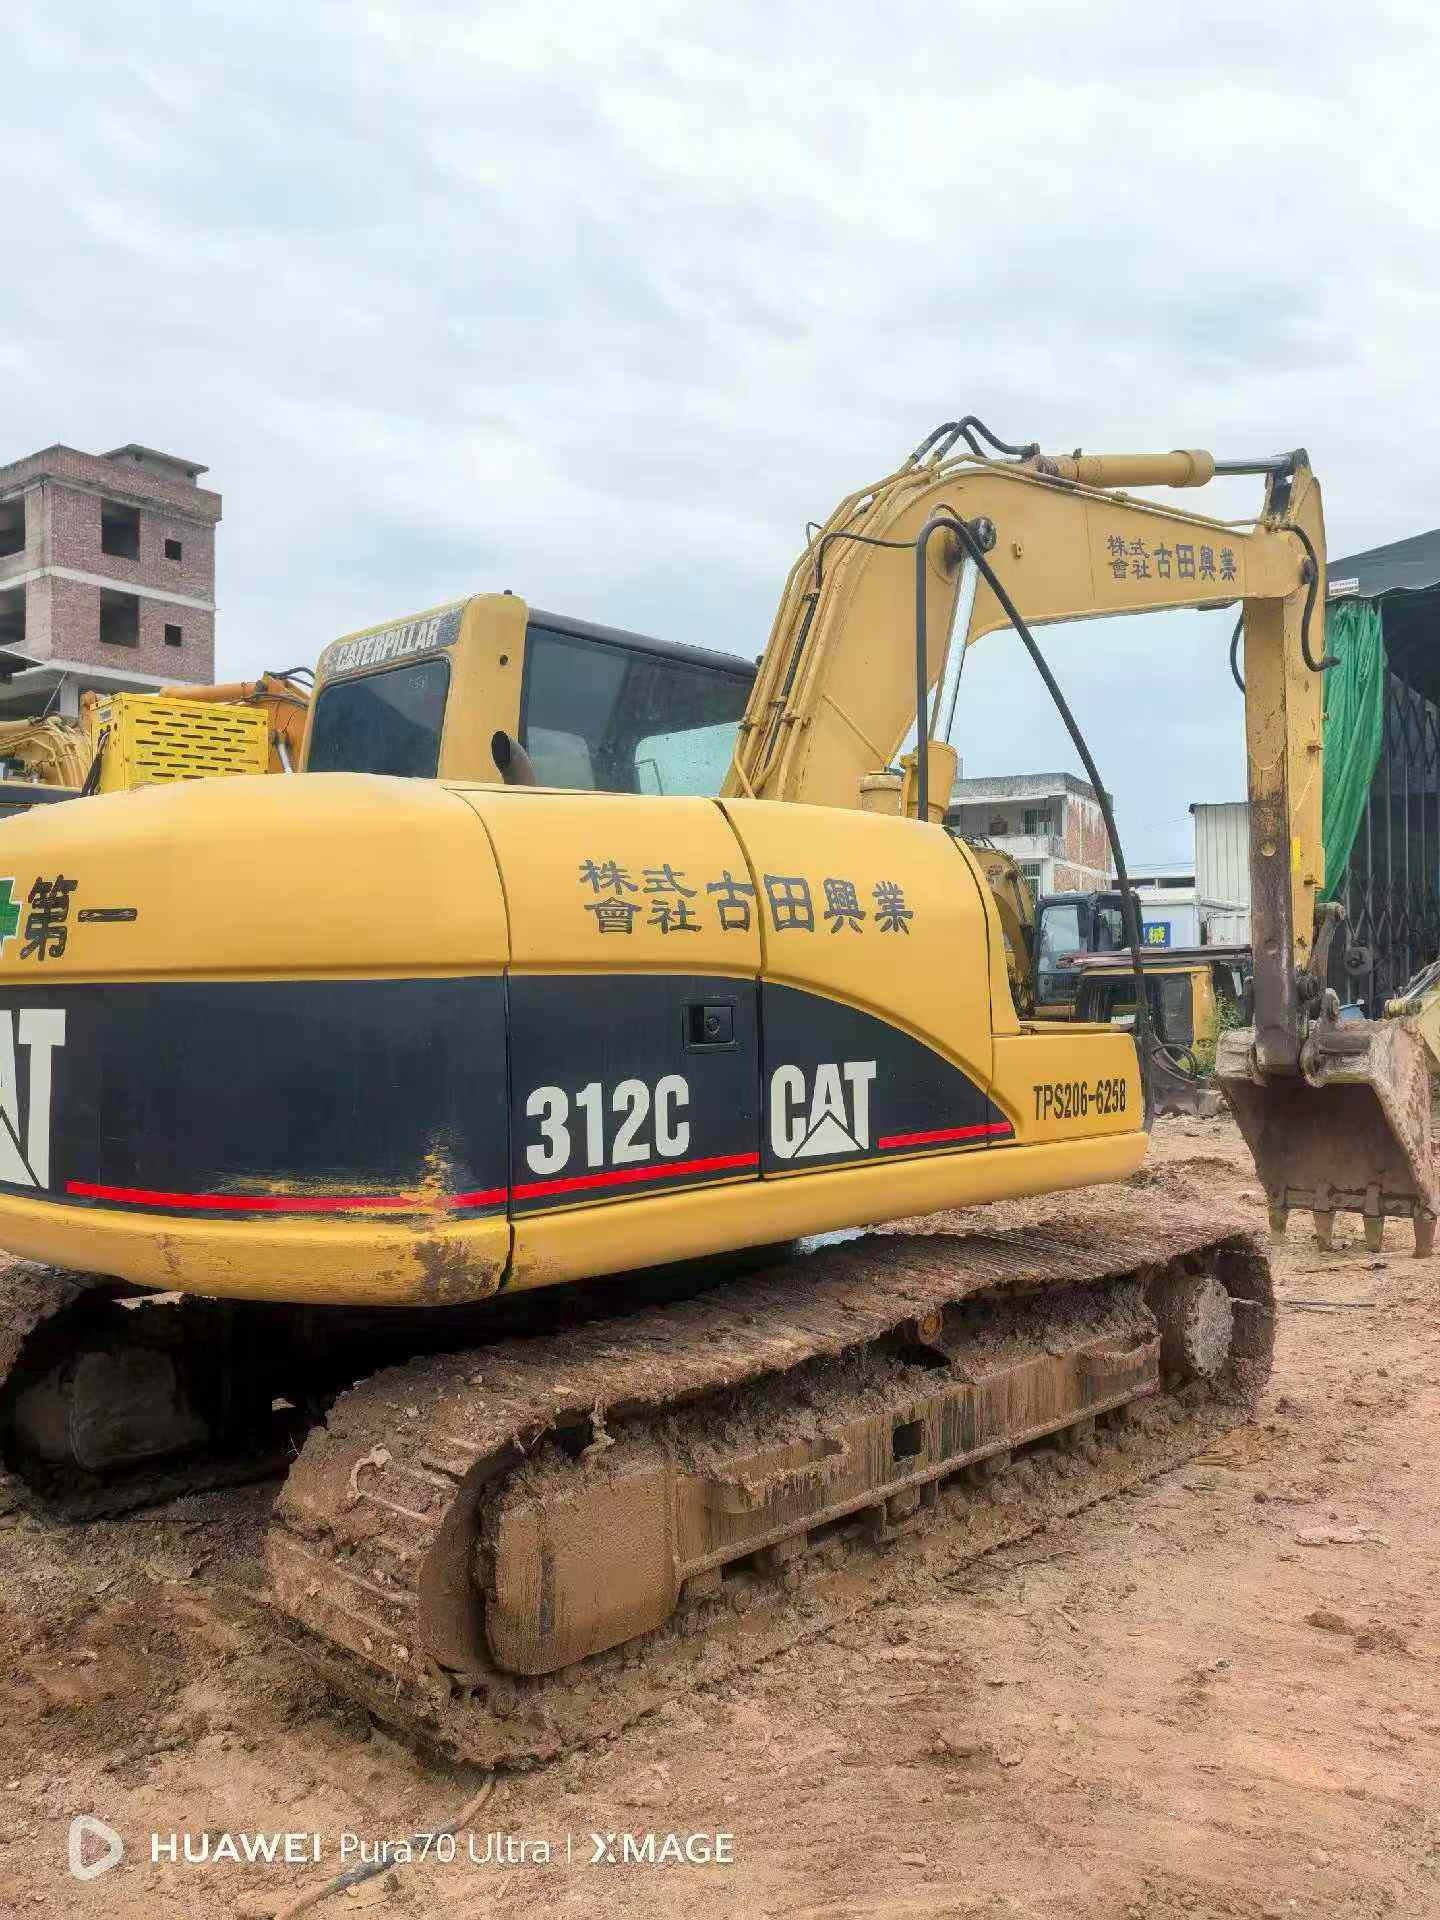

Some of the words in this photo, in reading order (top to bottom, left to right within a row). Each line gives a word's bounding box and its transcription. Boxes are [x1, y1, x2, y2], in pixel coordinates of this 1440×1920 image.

[335, 617, 441, 673] CATERPILLAR
[19, 874, 138, 961] 第一
[705, 870, 914, 936] 古田興業
[526, 1074, 690, 1175] 312C
[770, 1060, 877, 1160] CAT
[1033, 1078, 1126, 1120] TPS206-6258
